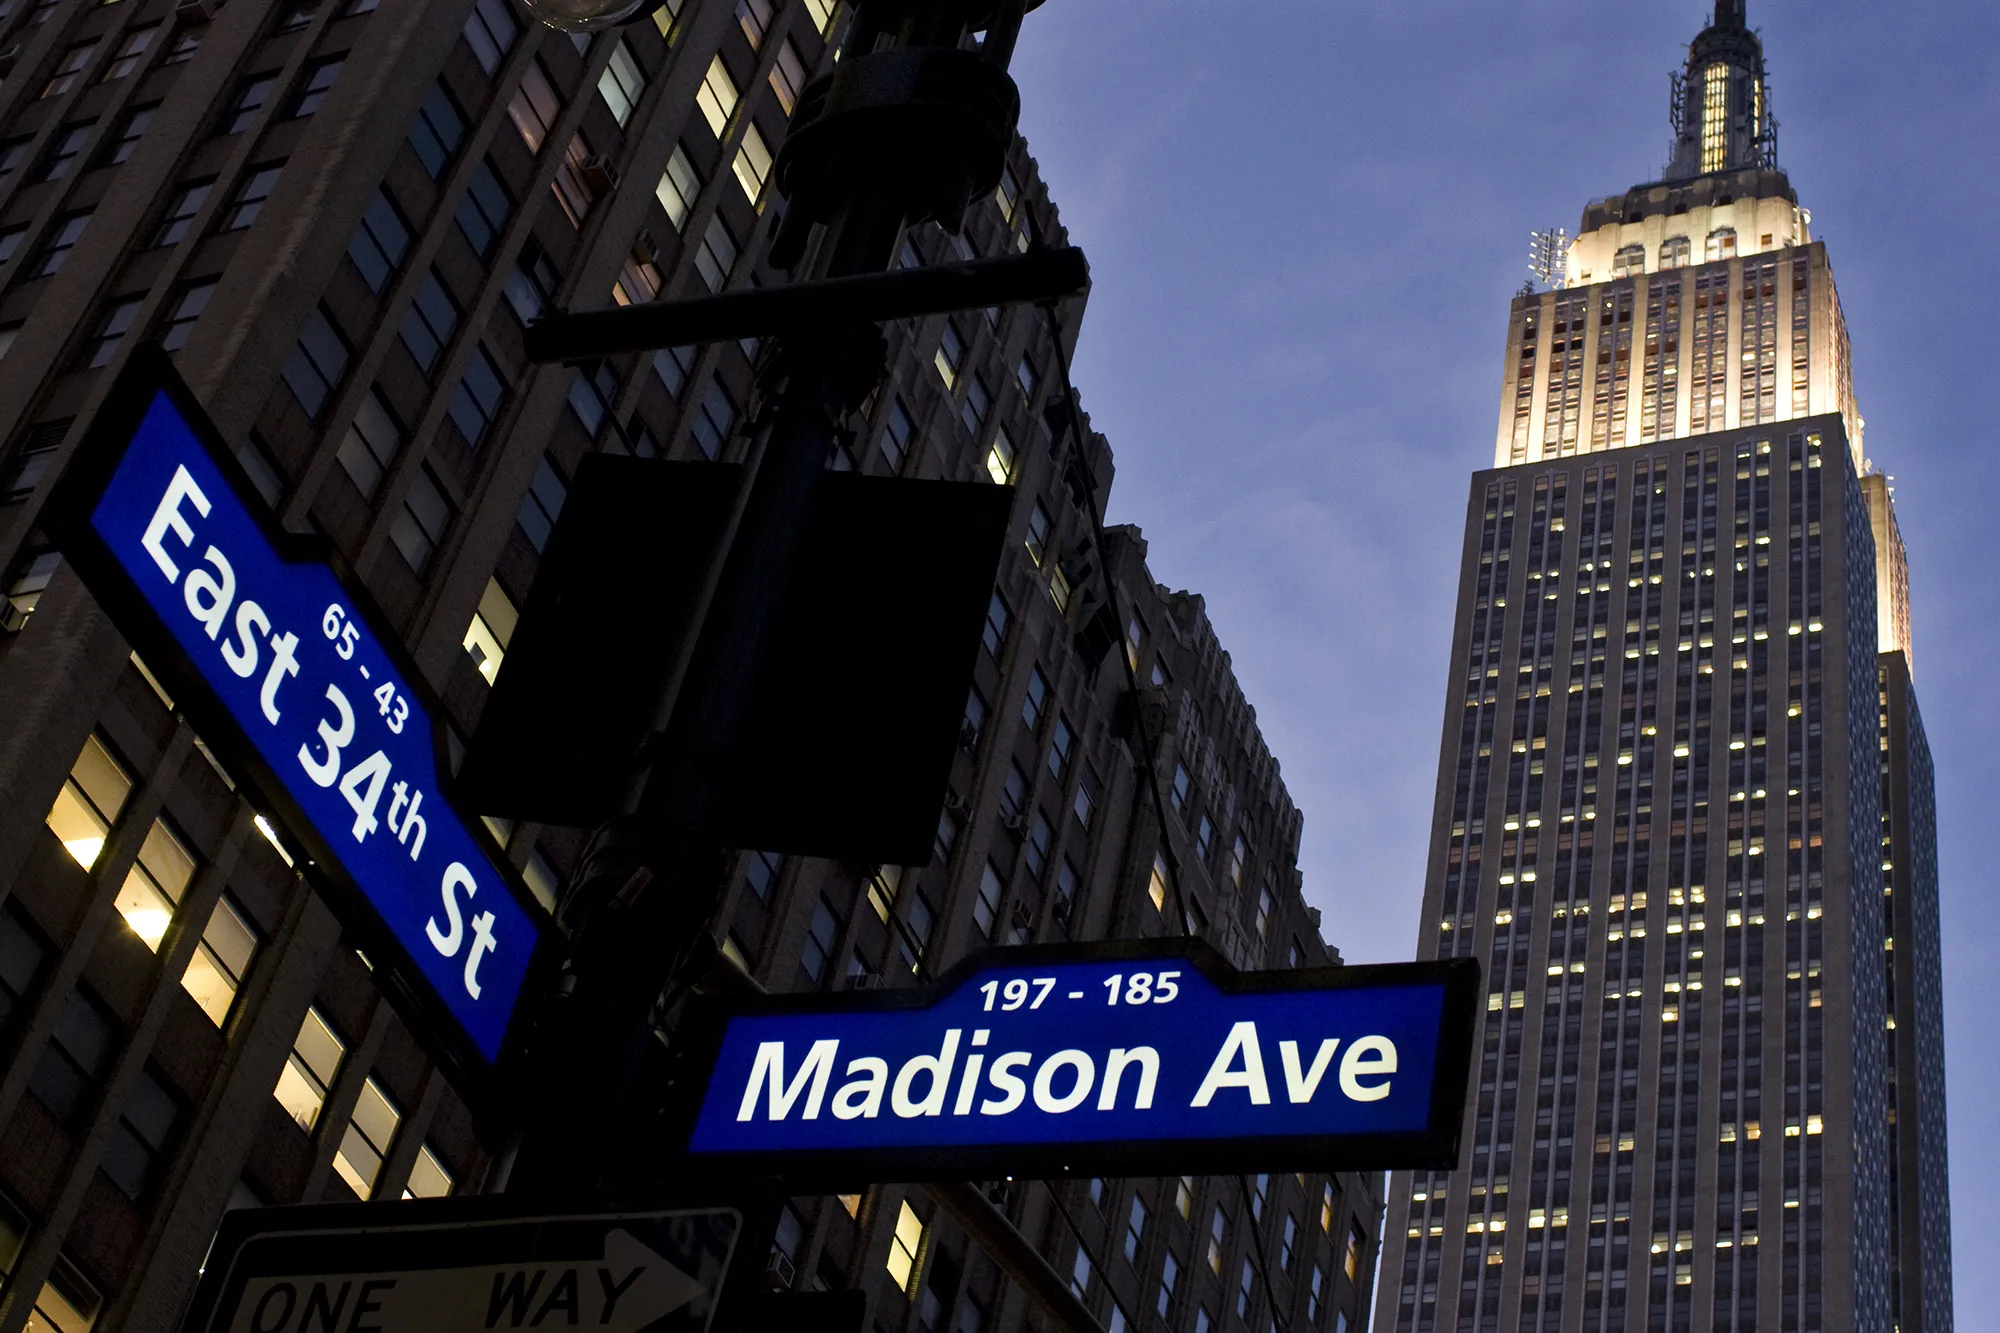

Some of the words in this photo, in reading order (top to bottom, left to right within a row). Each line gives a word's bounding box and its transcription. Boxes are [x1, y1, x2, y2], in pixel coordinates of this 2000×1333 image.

[322, 603, 360, 661] 65
[359, 664, 370, 680] -
[373, 681, 409, 735] 43
[141, 464, 299, 725] East
[298, 684, 426, 861] 34th
[426, 862, 496, 1000] St
[980, 977, 1056, 1012] 197
[1068, 991, 1084, 999] -
[1103, 971, 1181, 1005] 185
[736, 1028, 1159, 1121] Madison
[1190, 1022, 1398, 1107] Ave
[251, 1280, 397, 1333] ONE
[485, 1266, 647, 1328] WAY
